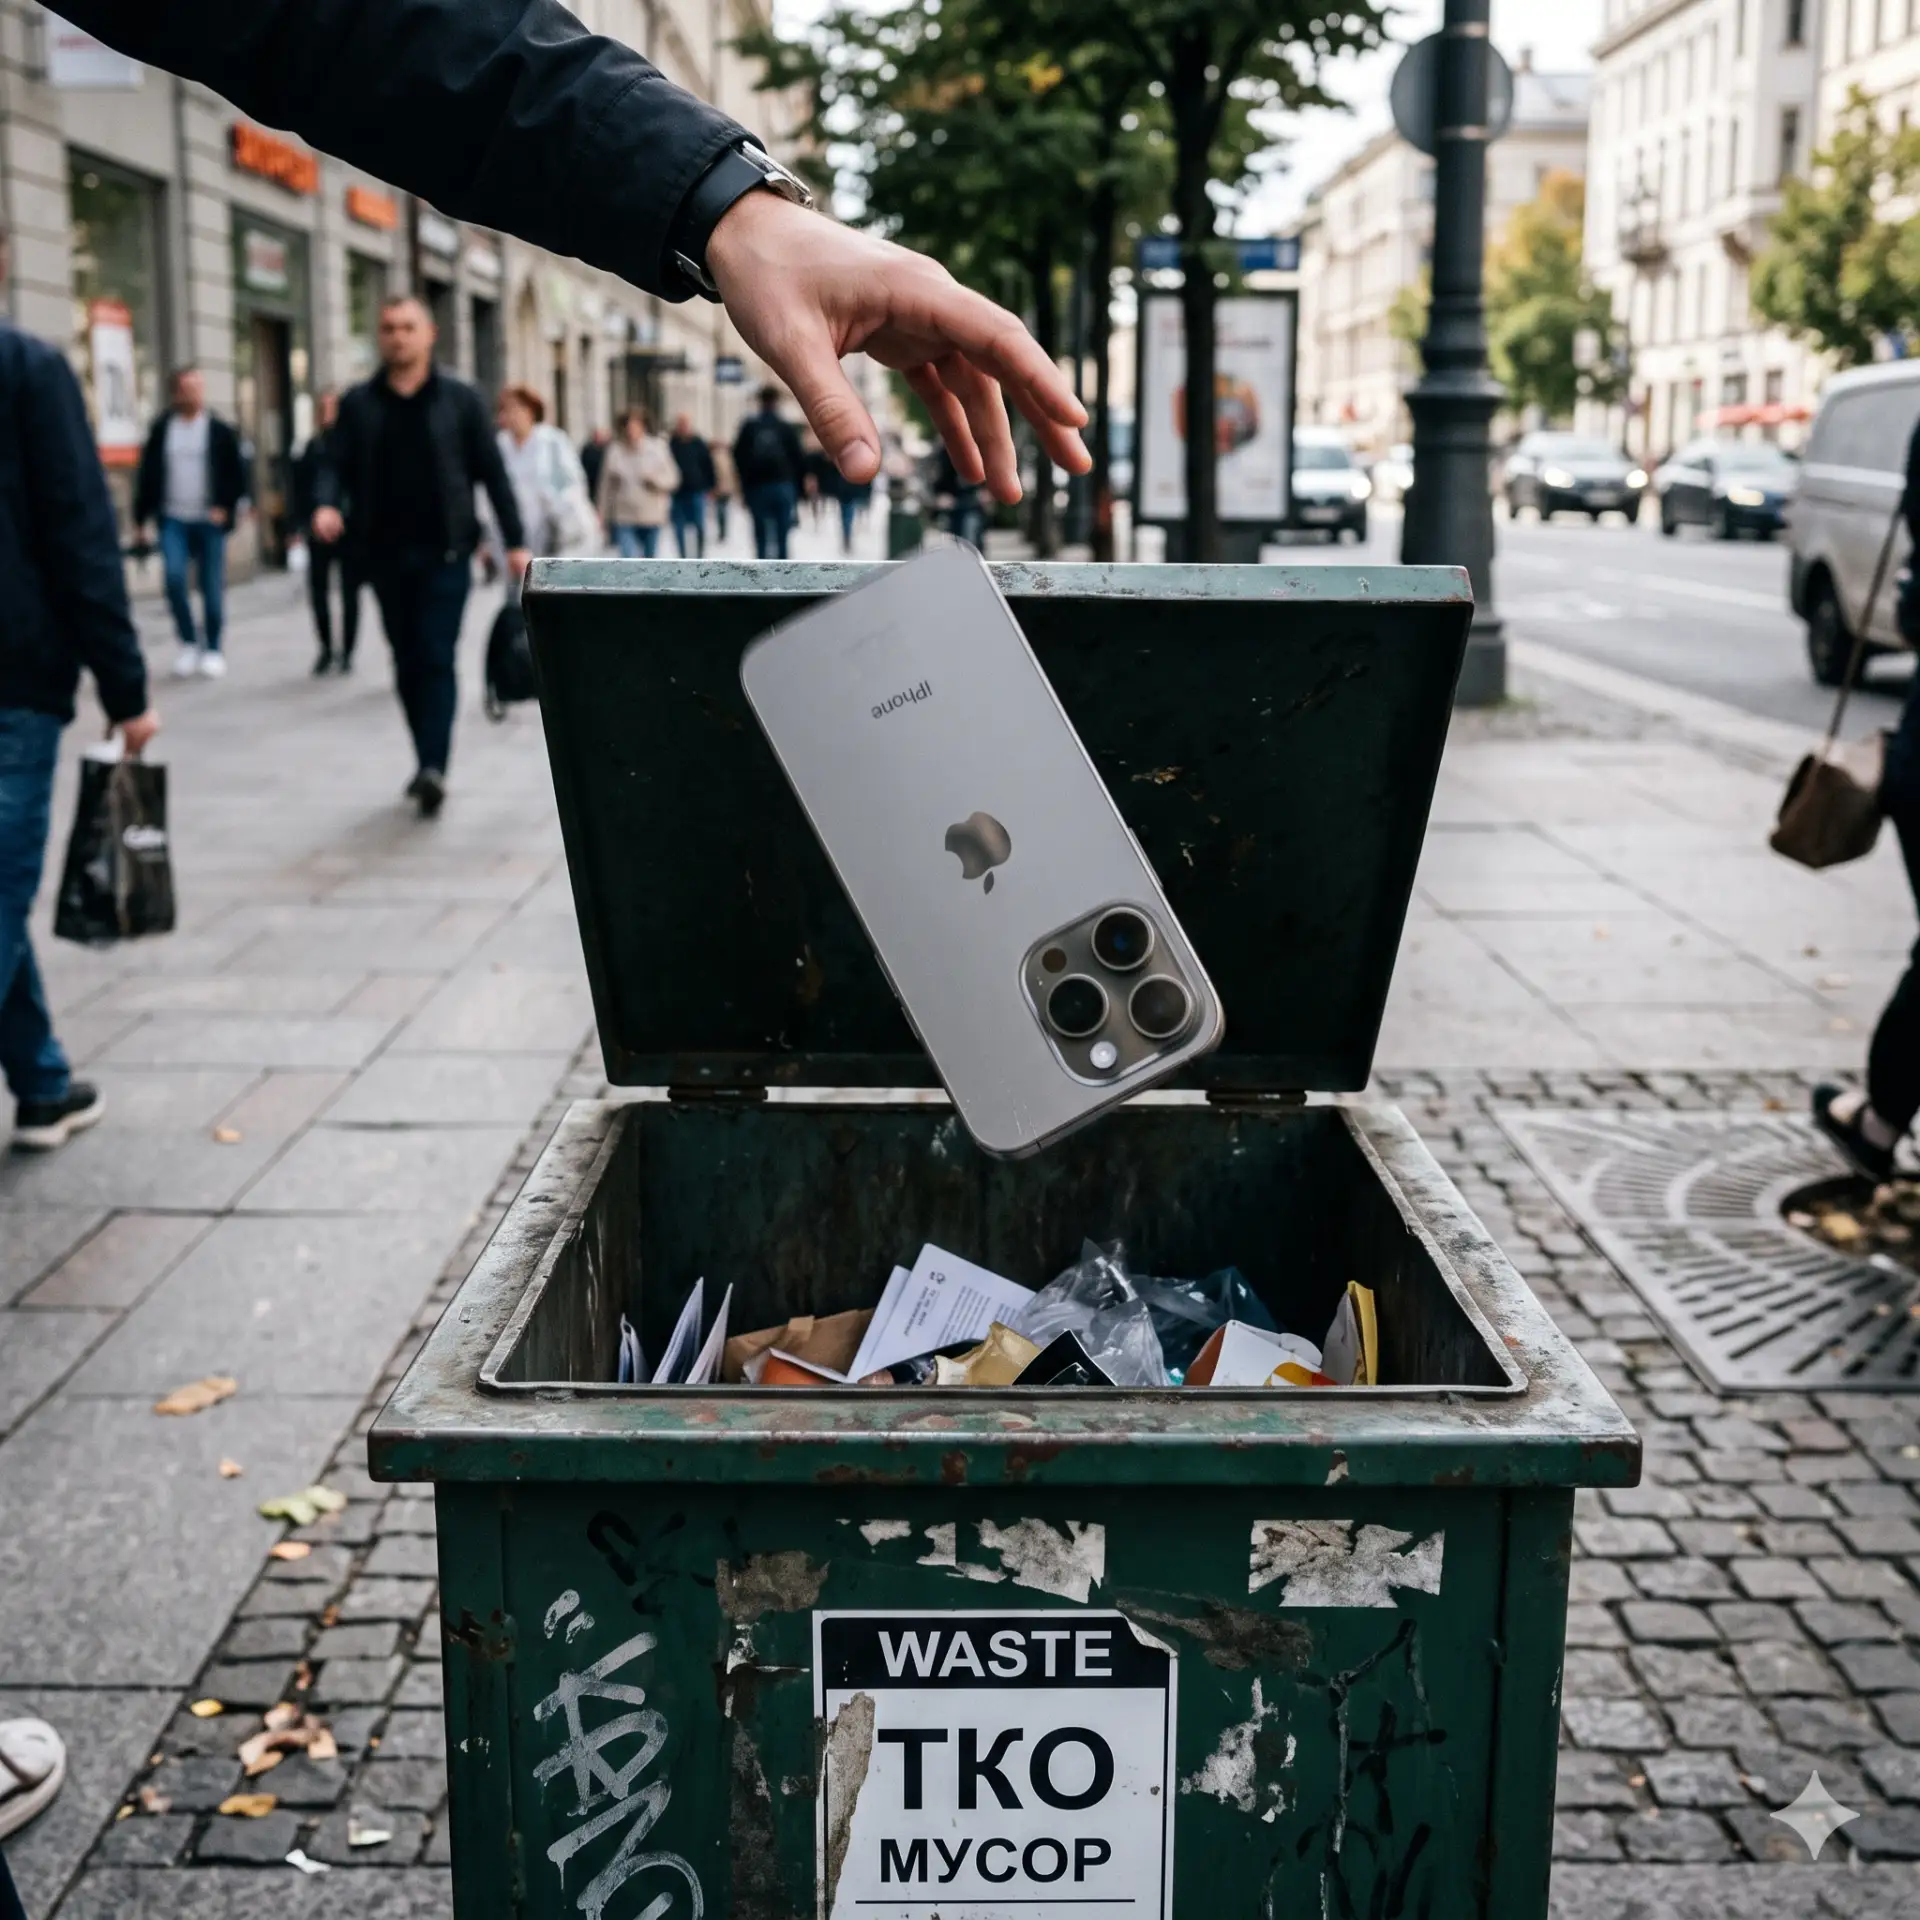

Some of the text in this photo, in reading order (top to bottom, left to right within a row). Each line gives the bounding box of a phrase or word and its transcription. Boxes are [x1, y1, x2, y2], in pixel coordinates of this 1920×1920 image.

[871, 680, 932, 719] iPhone
[878, 1630, 1113, 1678] WASTE
[877, 1726, 1115, 1811] ТКО
[880, 1837, 1112, 1884] МУСОР
